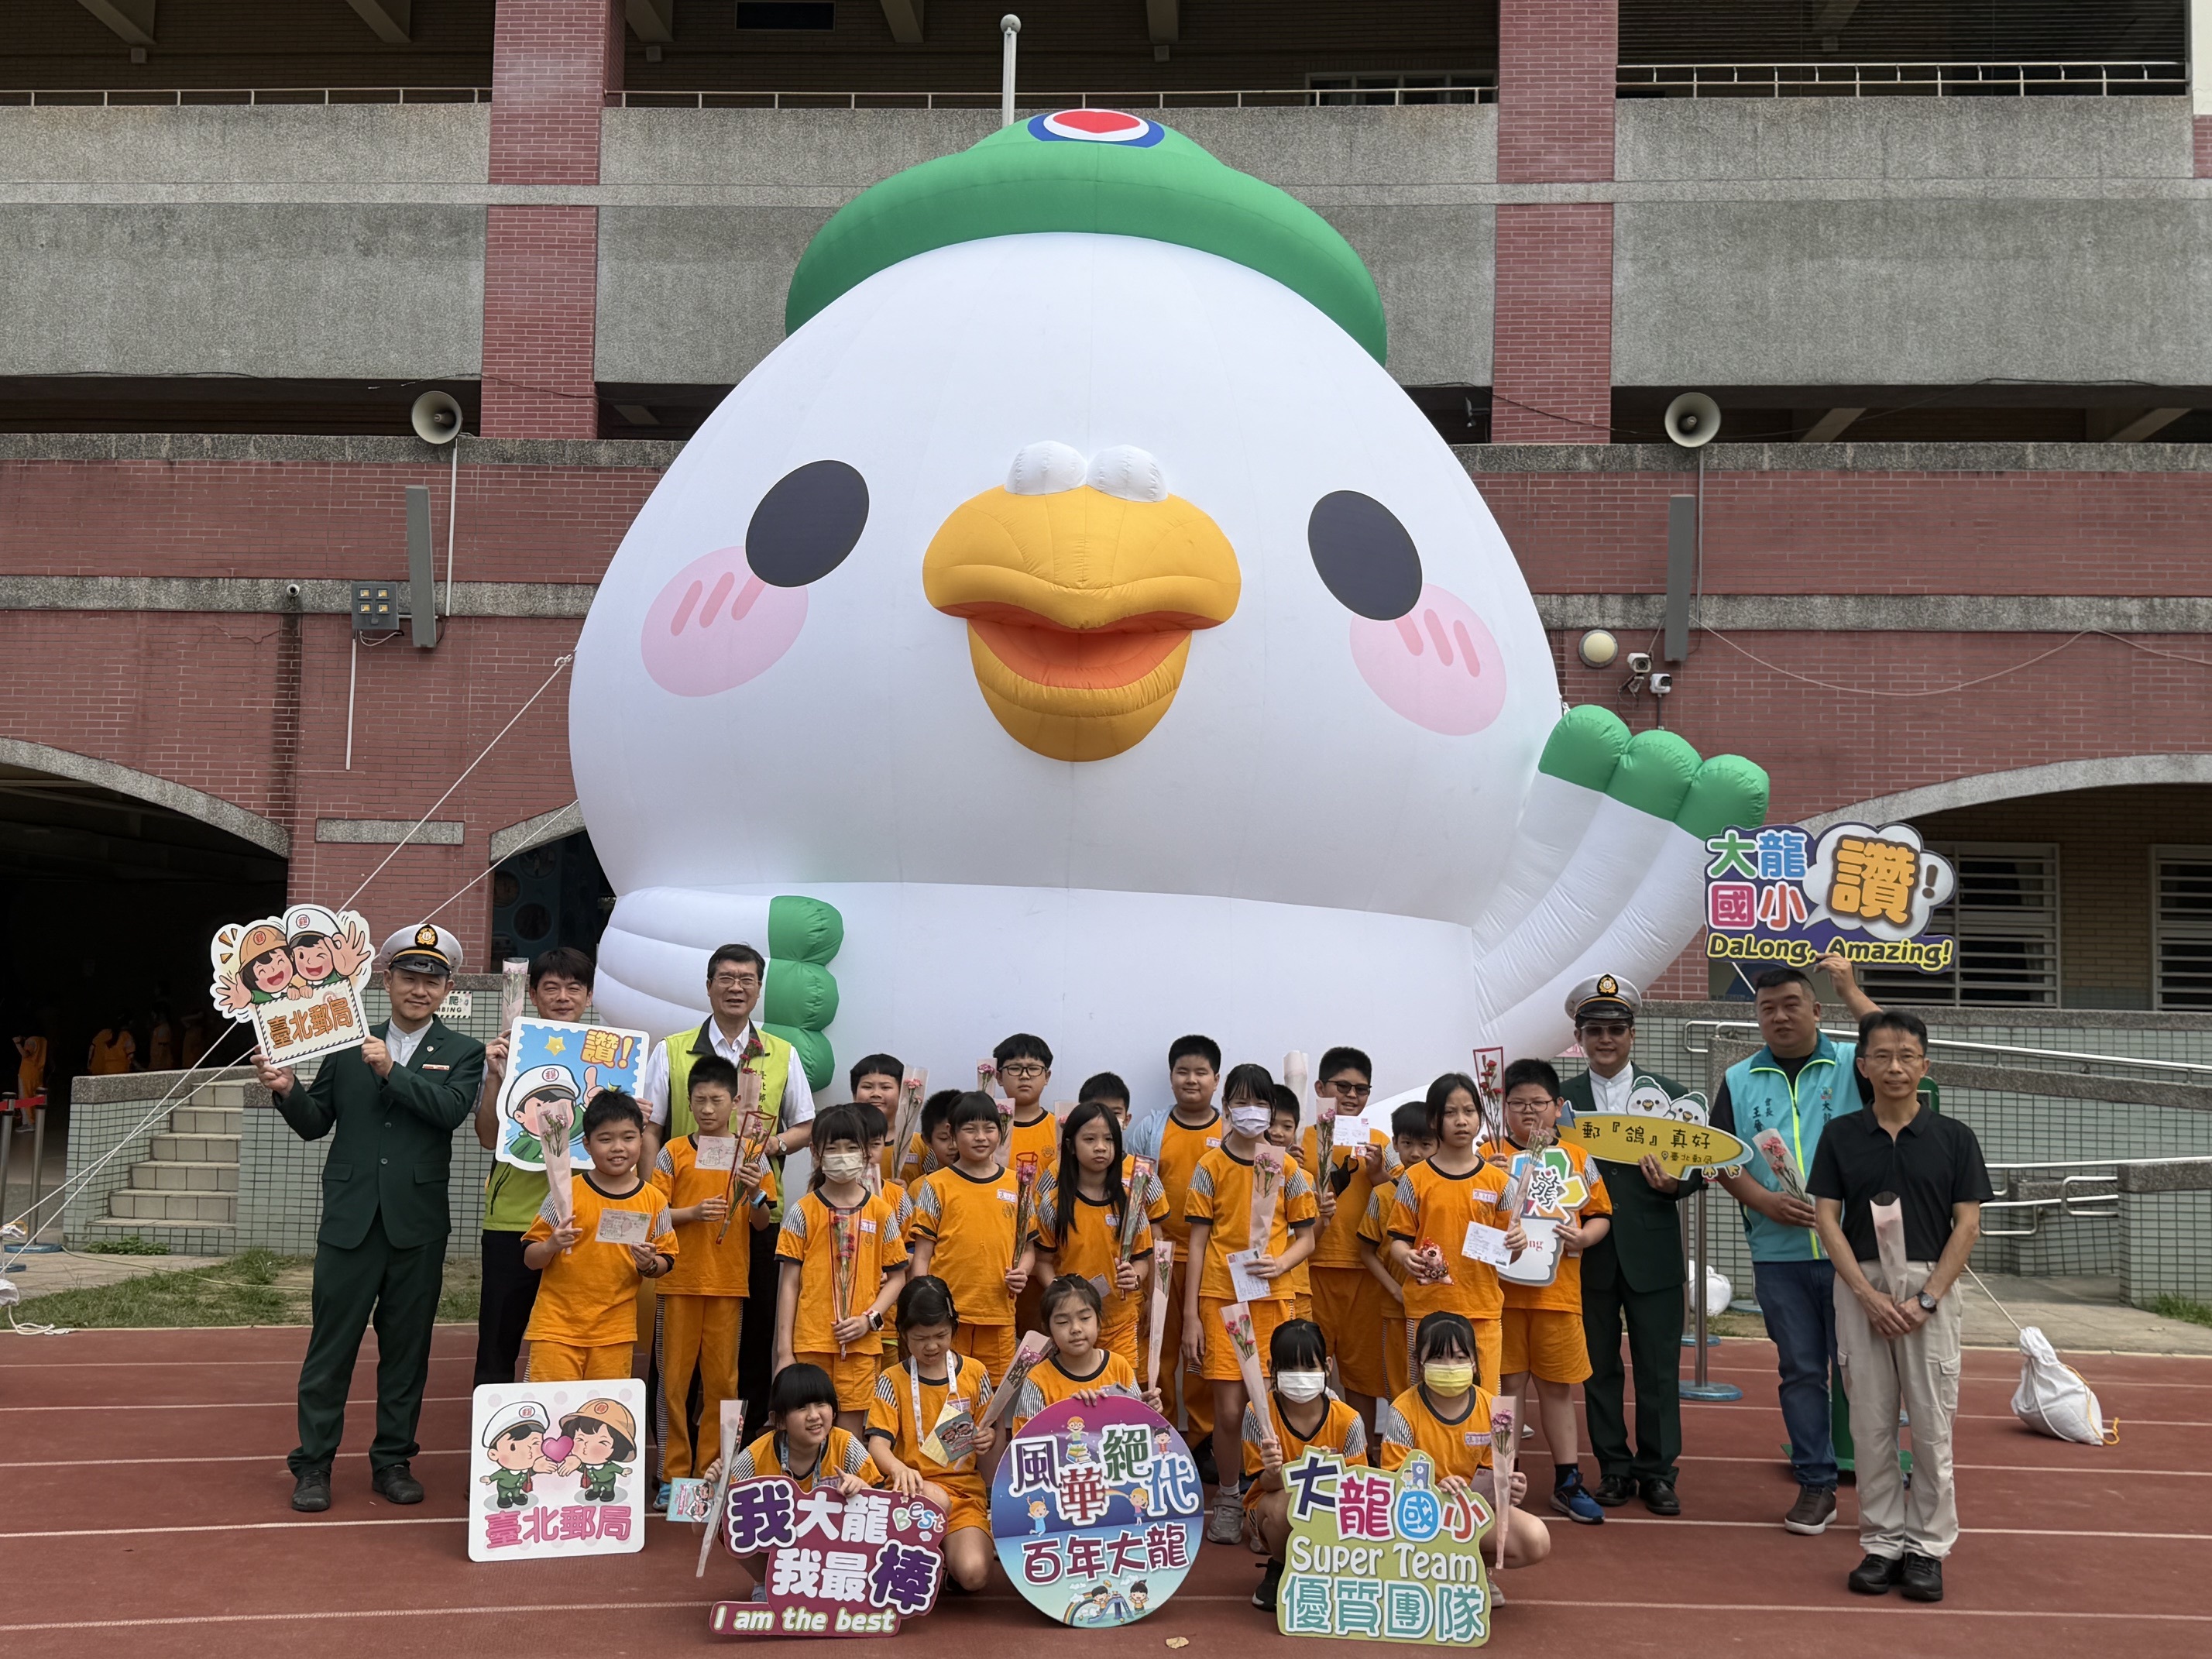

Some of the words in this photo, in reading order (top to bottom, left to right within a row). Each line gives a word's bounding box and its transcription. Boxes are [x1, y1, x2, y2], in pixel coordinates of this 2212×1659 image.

[1708, 831, 1807, 880] 大龍
[1708, 881, 1808, 930] 國小
[1826, 936, 1953, 971] Amazing!
[266, 997, 354, 1049] 臺北郵局
[1010, 1425, 1198, 1525] 風華絕代
[1286, 1453, 1490, 1541] 大龍國小
[485, 1505, 631, 1549] 臺北郵局
[730, 1482, 891, 1551] 我大龍
[772, 1541, 940, 1613] 我最棒
[1022, 1523, 1190, 1584] 百年大龍
[1291, 1536, 1383, 1575] Super
[1393, 1543, 1478, 1582] Team
[714, 1606, 727, 1629] I
[733, 1611, 775, 1630] am
[782, 1606, 828, 1631] the
[835, 1607, 897, 1633] best
[1283, 1573, 1485, 1641] 優質團隊
